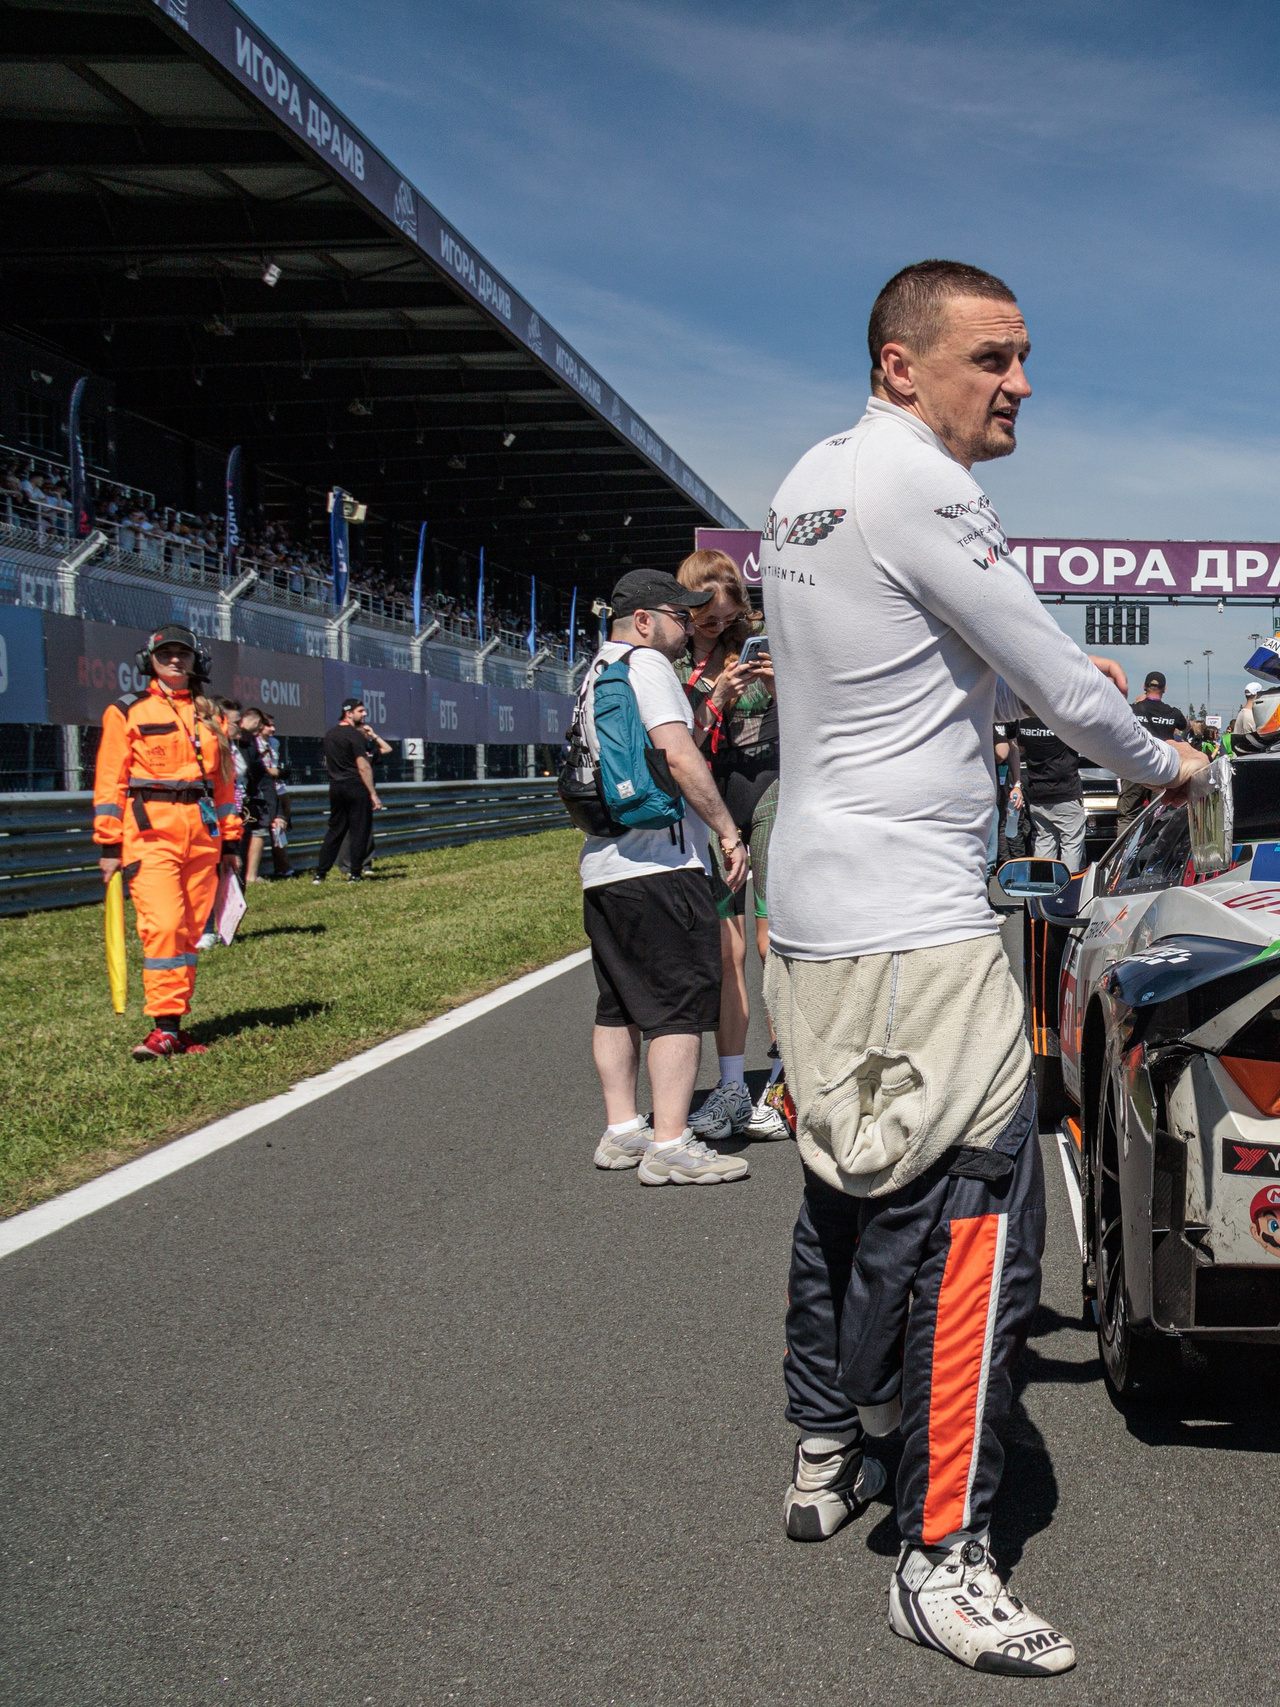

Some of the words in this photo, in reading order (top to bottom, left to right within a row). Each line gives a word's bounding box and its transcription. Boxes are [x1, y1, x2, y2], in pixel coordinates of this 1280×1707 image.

[236, 26, 303, 125] ИГОРА
[306, 98, 365, 181] ДРАЙВ
[440, 229, 477, 288] ИГОРА
[478, 267, 512, 320] ДРАЙВ
[362, 689, 387, 725] ВТБ
[440, 700, 458, 731] ВТБ
[499, 705, 515, 732] ВТБ
[547, 709, 559, 733] ВТБ
[408, 743, 417, 756] 2
[1003, 1631, 1065, 1662] OMP
